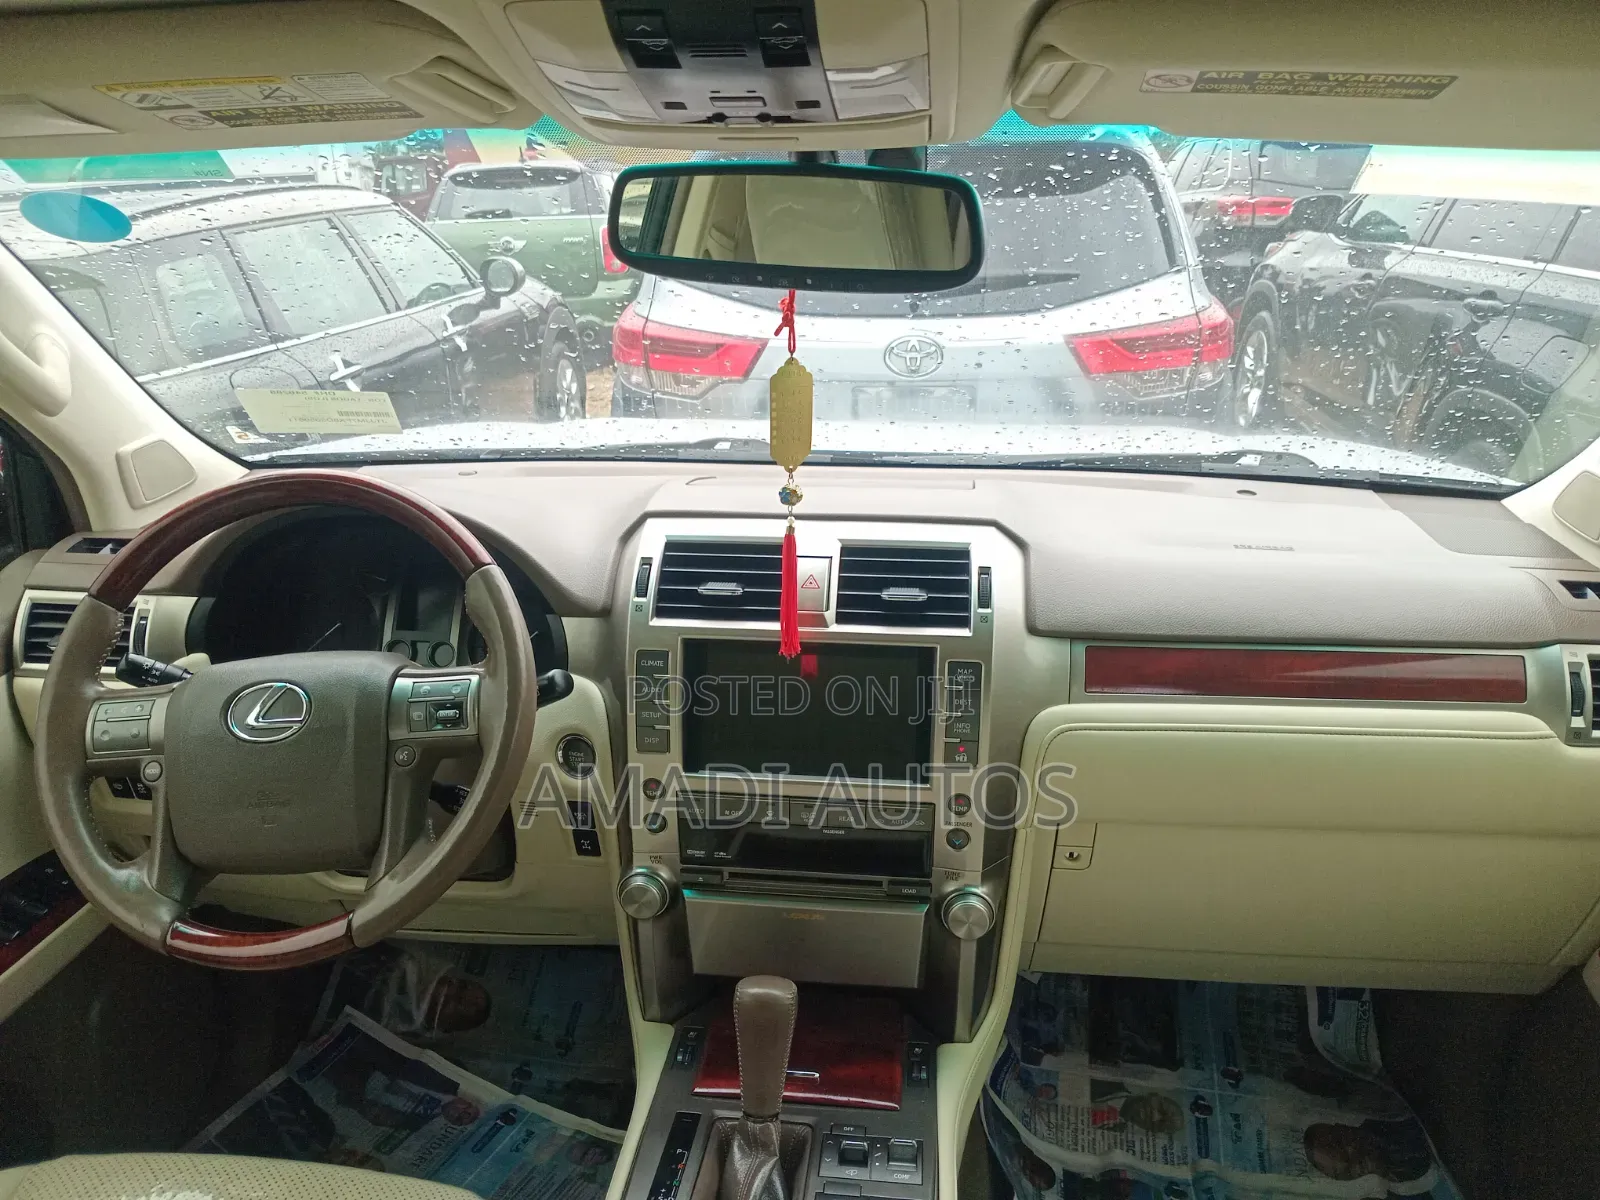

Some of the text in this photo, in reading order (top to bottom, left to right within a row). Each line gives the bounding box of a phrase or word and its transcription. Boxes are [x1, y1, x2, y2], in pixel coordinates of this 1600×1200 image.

[1202, 71, 1452, 84] AIR BAG WARNING
[640, 659, 665, 667] CLIMATE
